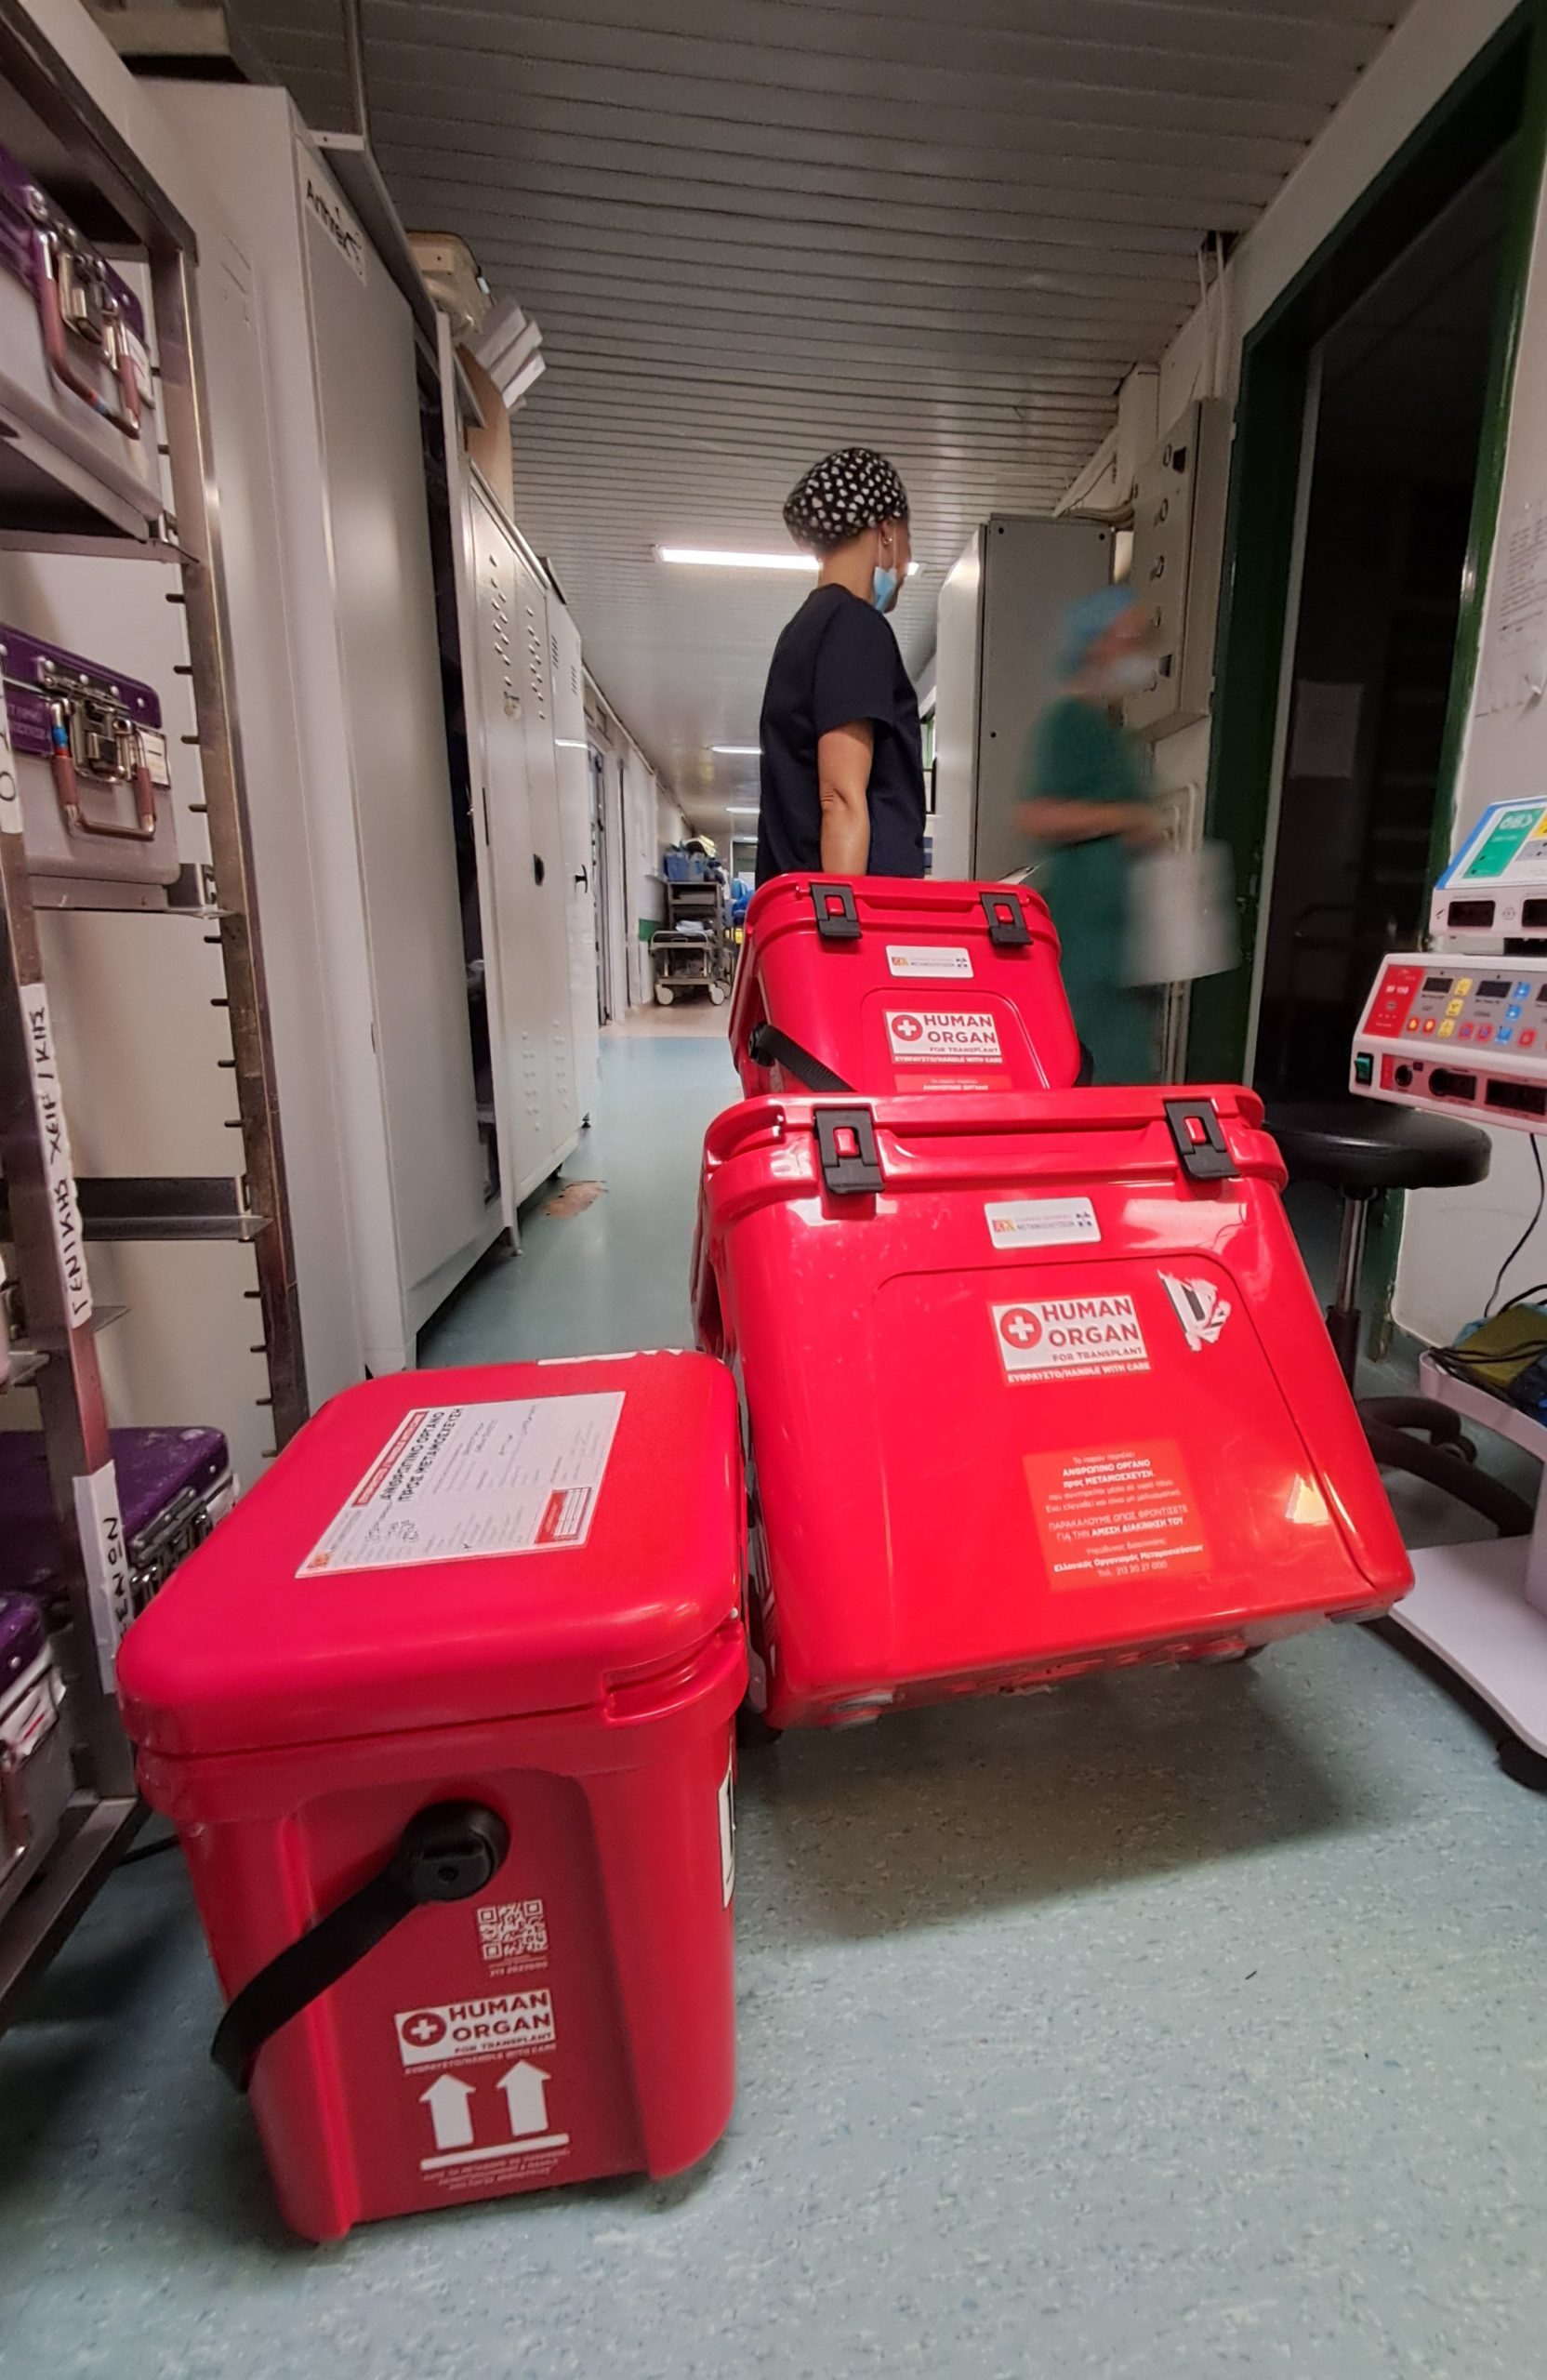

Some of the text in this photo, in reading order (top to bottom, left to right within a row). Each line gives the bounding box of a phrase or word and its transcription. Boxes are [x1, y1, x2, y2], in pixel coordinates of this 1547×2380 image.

[923, 1014, 992, 1027] HUMAN
[927, 1031, 997, 1043] ORGAN
[1041, 1298, 1132, 1322] HUMAN
[1048, 1324, 1139, 1347] ORGAN
[1052, 1347, 1143, 1363] FOR TRANSPLANT
[1103, 1364, 1126, 1375] WITH
[1127, 1361, 1151, 1371] CARE
[379, 1445, 425, 1501] ΑΝΘΡΩΠΙΝΟ
[416, 1411, 445, 1443] ΟΡΓΑΝΟ
[397, 1475, 425, 1501] ΠΡΟΣ
[414, 1408, 463, 1476] ΜΕΤΑΜΟΣΧΕΥΣΗ
[1063, 1459, 1150, 1476] ΑΝΘΡΩΠΙΝΟ ΟΡΓΑΝΟ
[1063, 1470, 1154, 1489] προς ΜΕΤΑΜΟΣΧΕΥΣΗ
[1049, 1514, 1112, 1530] ΠΑΡΑΚΑΛΟΥΜΕ
[1056, 1517, 1183, 1541] ΓΙΑ ΤΗΝ ΑΜΕΣΗ ΔΙΑΚΙΝΗΣΗ ΤΟΥ
[450, 1990, 549, 2021] HUMAN
[452, 2014, 551, 2042] ORGAN
[454, 2032, 552, 2054] FOR TRANSPLANT
